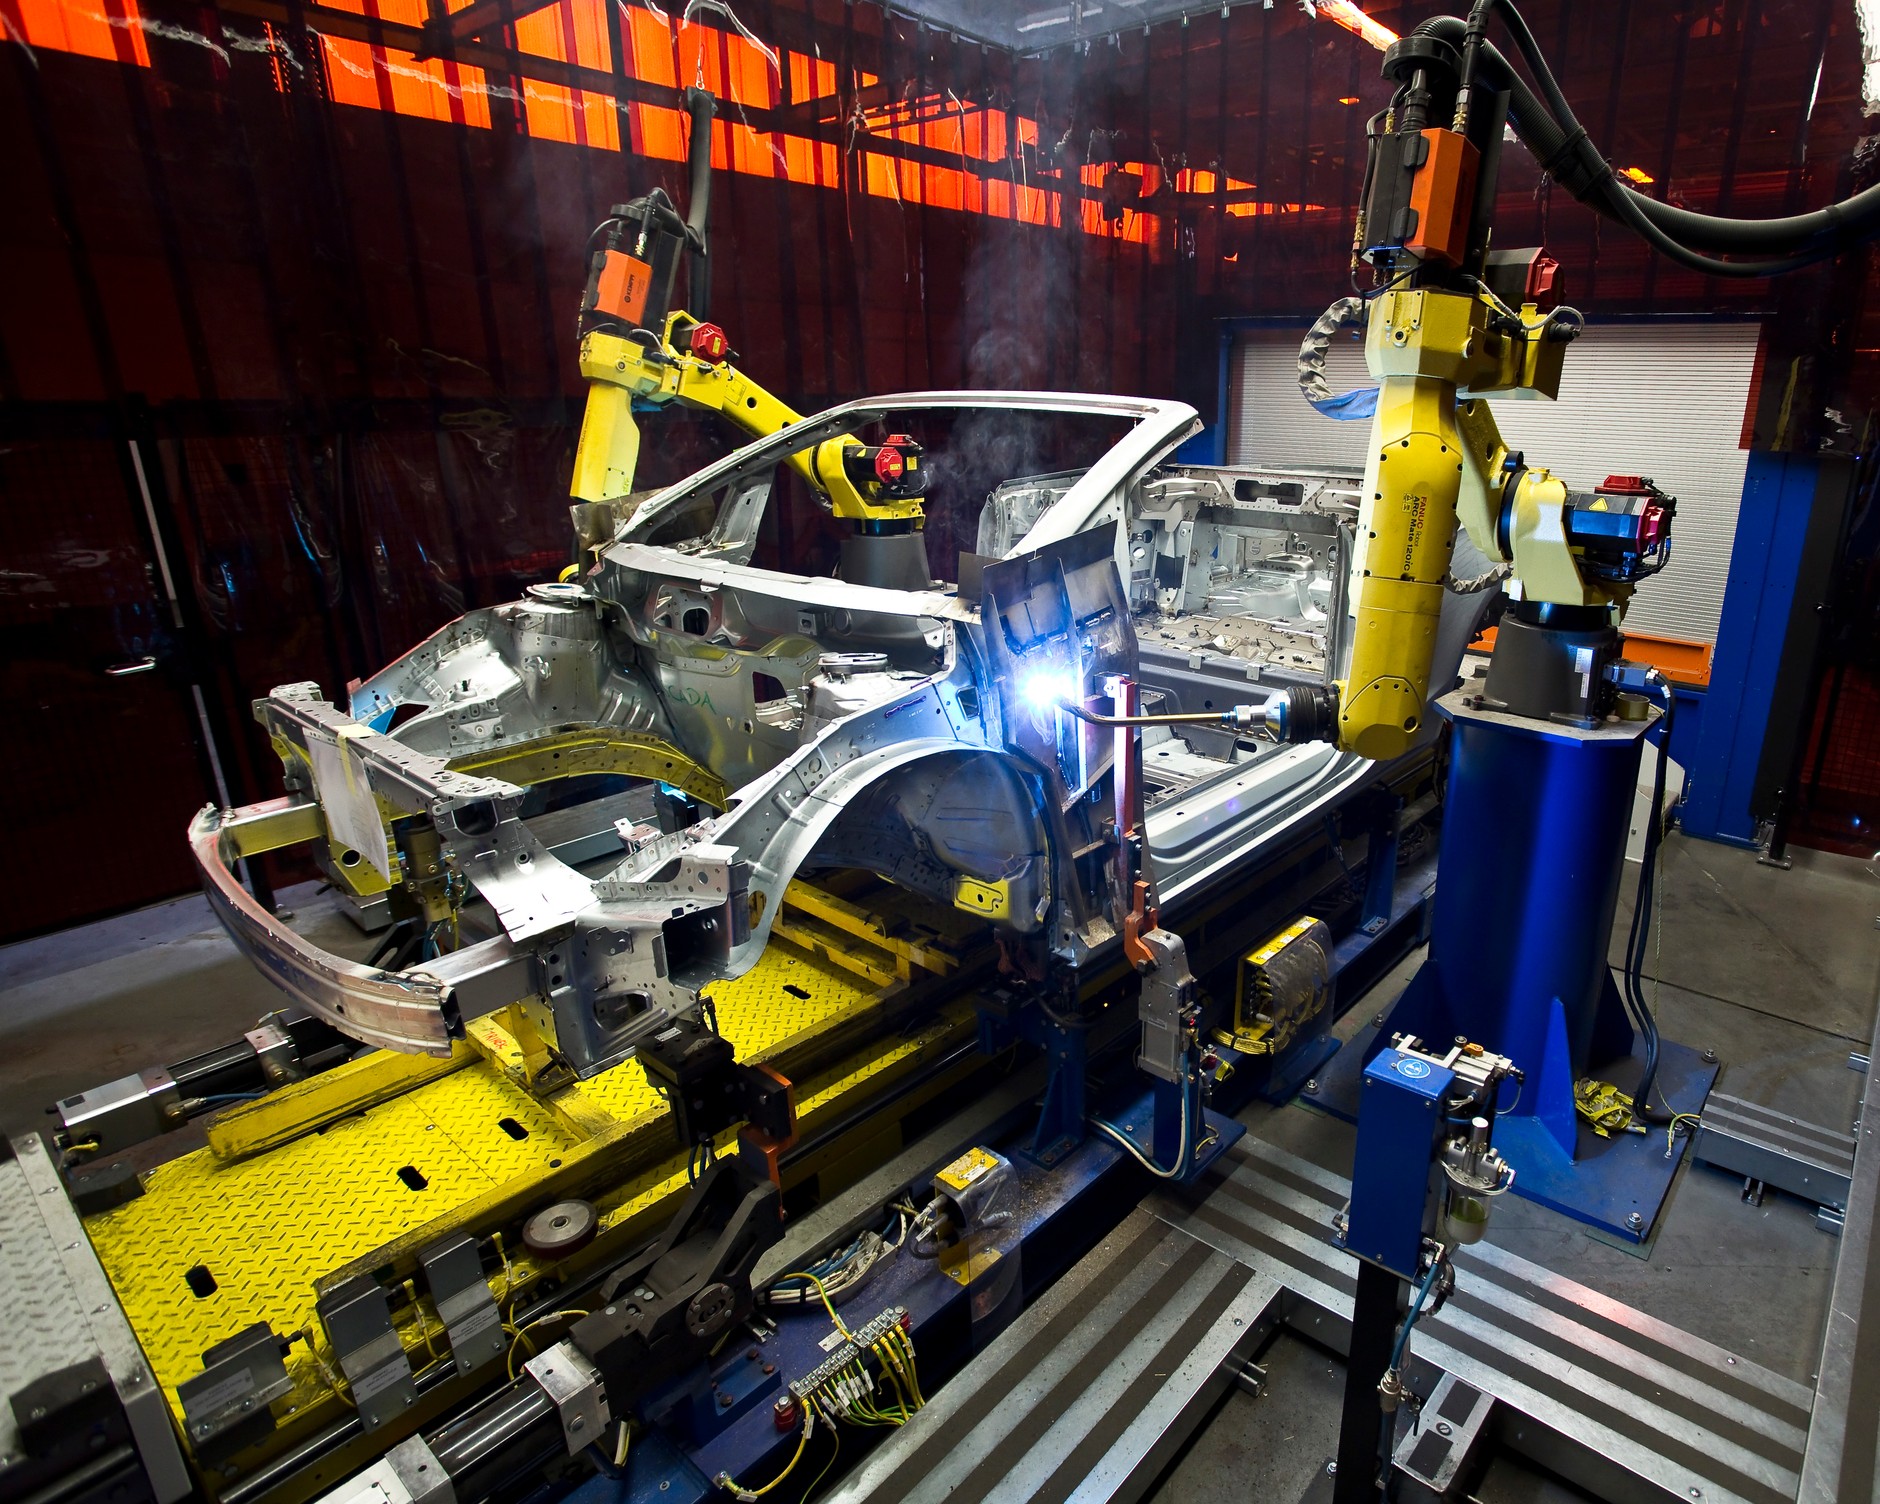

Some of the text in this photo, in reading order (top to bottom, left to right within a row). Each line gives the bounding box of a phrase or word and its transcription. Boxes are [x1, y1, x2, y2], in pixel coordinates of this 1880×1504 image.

[1404, 496, 1420, 571] ARC Mate 120iC
[1417, 496, 1427, 529] FANUC
